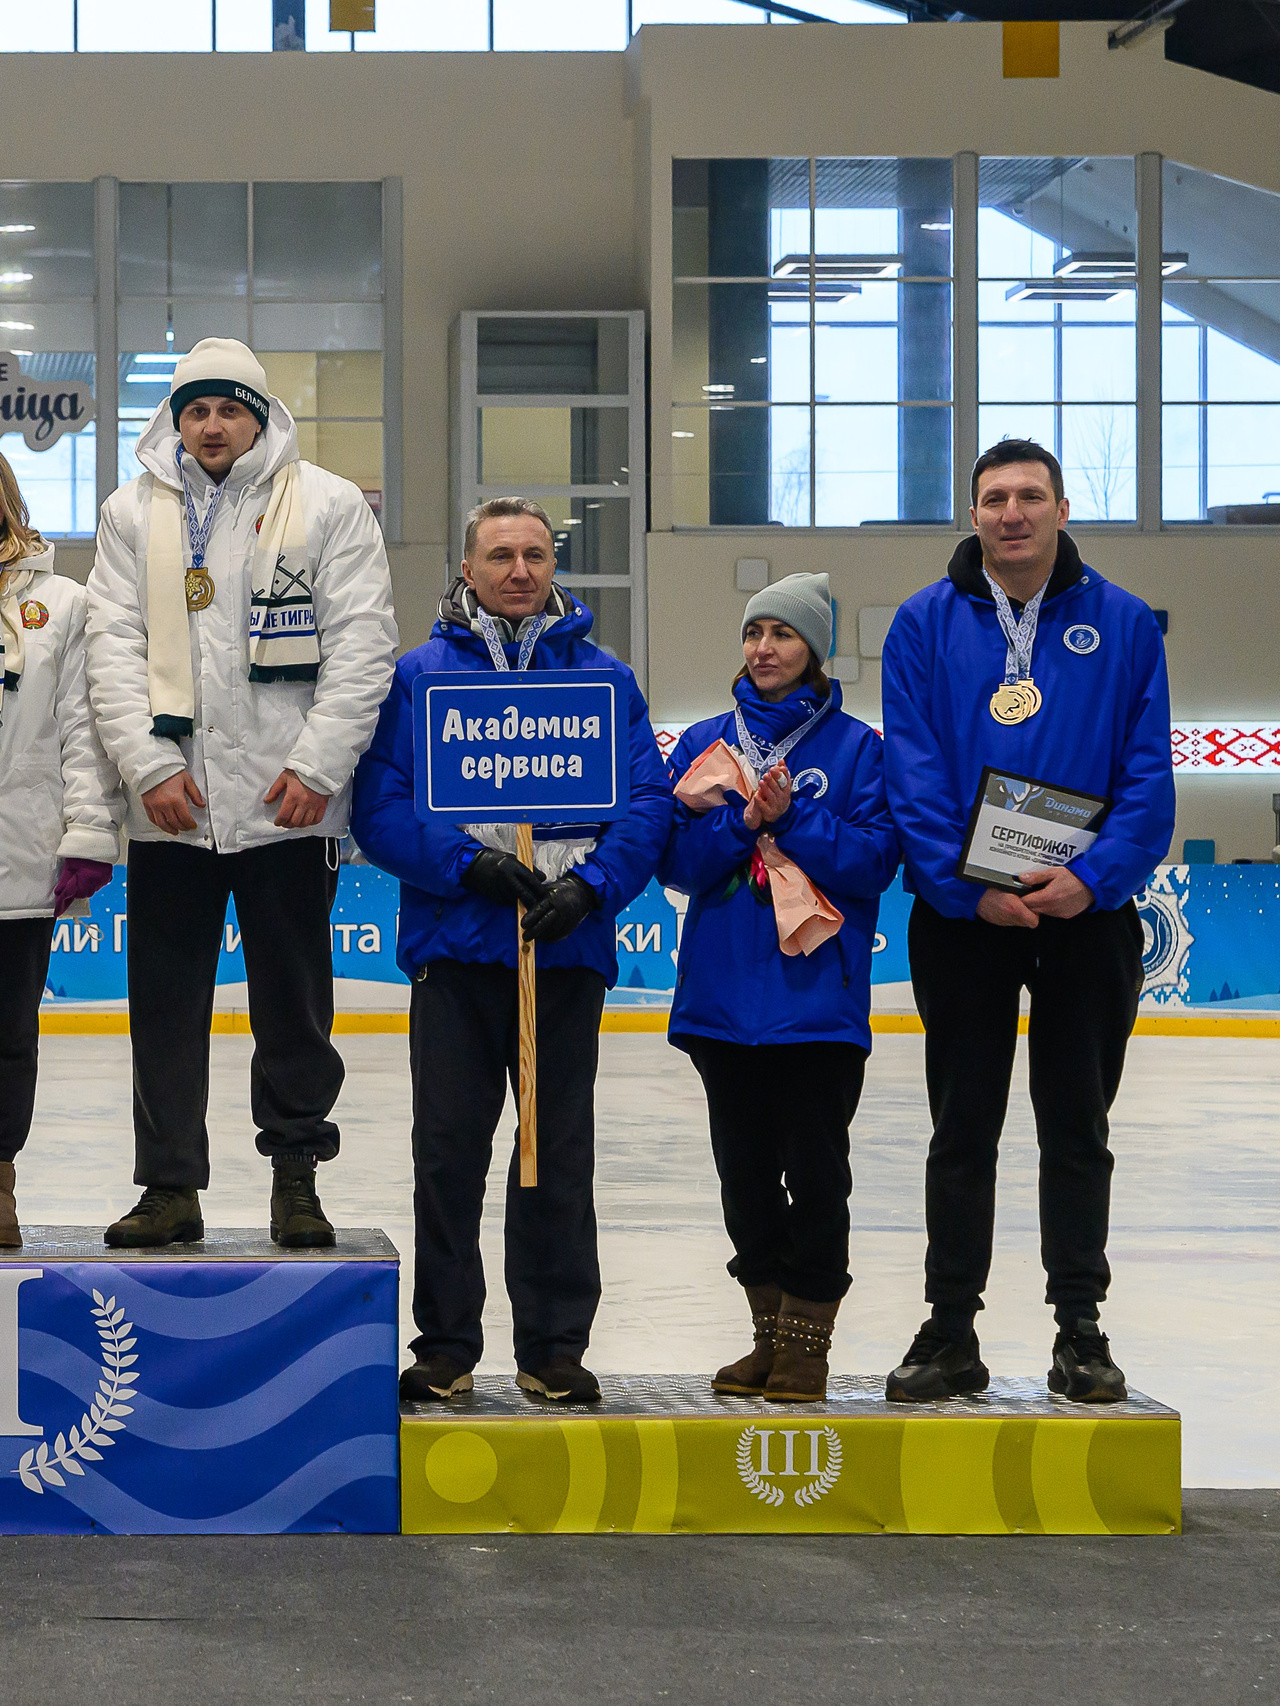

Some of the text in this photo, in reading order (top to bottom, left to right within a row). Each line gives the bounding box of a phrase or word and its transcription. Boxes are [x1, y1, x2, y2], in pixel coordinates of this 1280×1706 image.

[442, 705, 601, 743] Академия
[461, 753, 583, 789] сервиса
[991, 825, 1077, 858] СЕРТИФИКАТ
[755, 1430, 825, 1475] III
